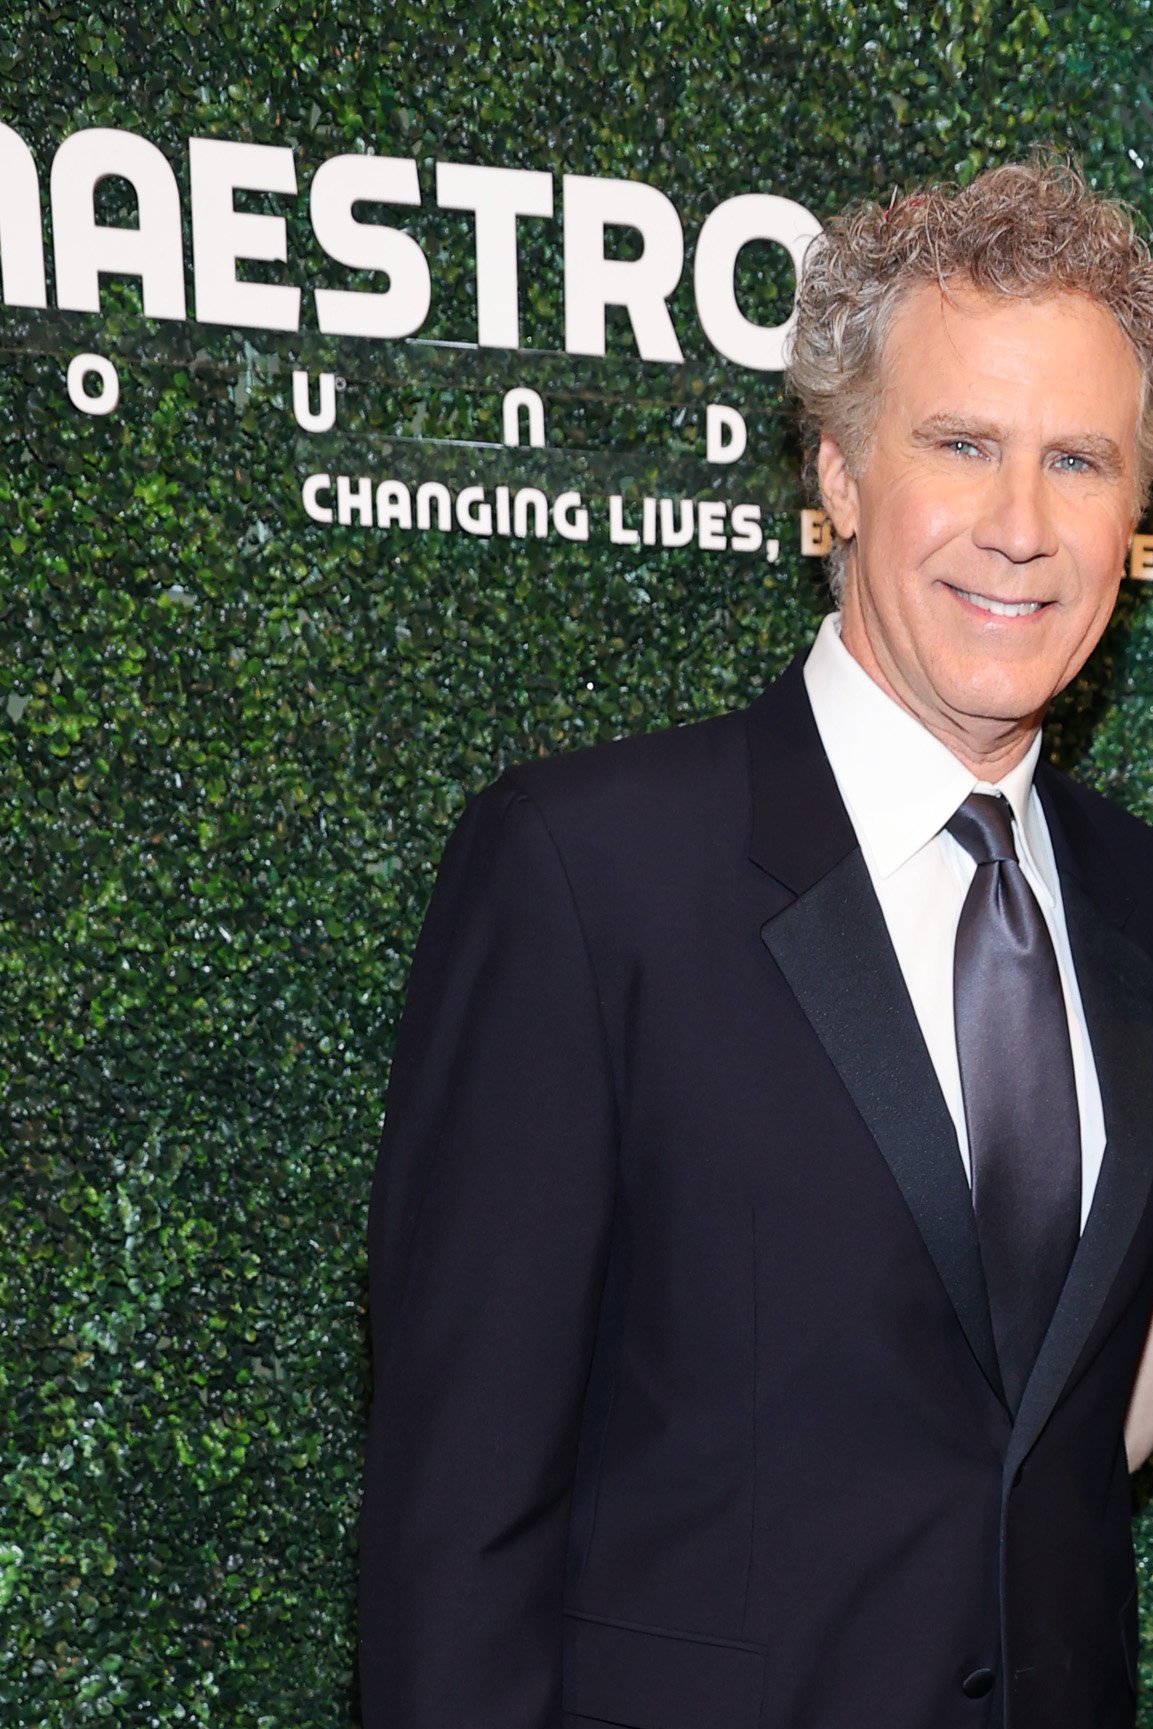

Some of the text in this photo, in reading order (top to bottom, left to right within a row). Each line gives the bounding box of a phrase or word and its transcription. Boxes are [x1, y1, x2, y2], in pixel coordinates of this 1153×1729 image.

[0, 122, 825, 371] AESTRO
[302, 473, 589, 542] CHANGING
[609, 495, 780, 563] LIVES,
